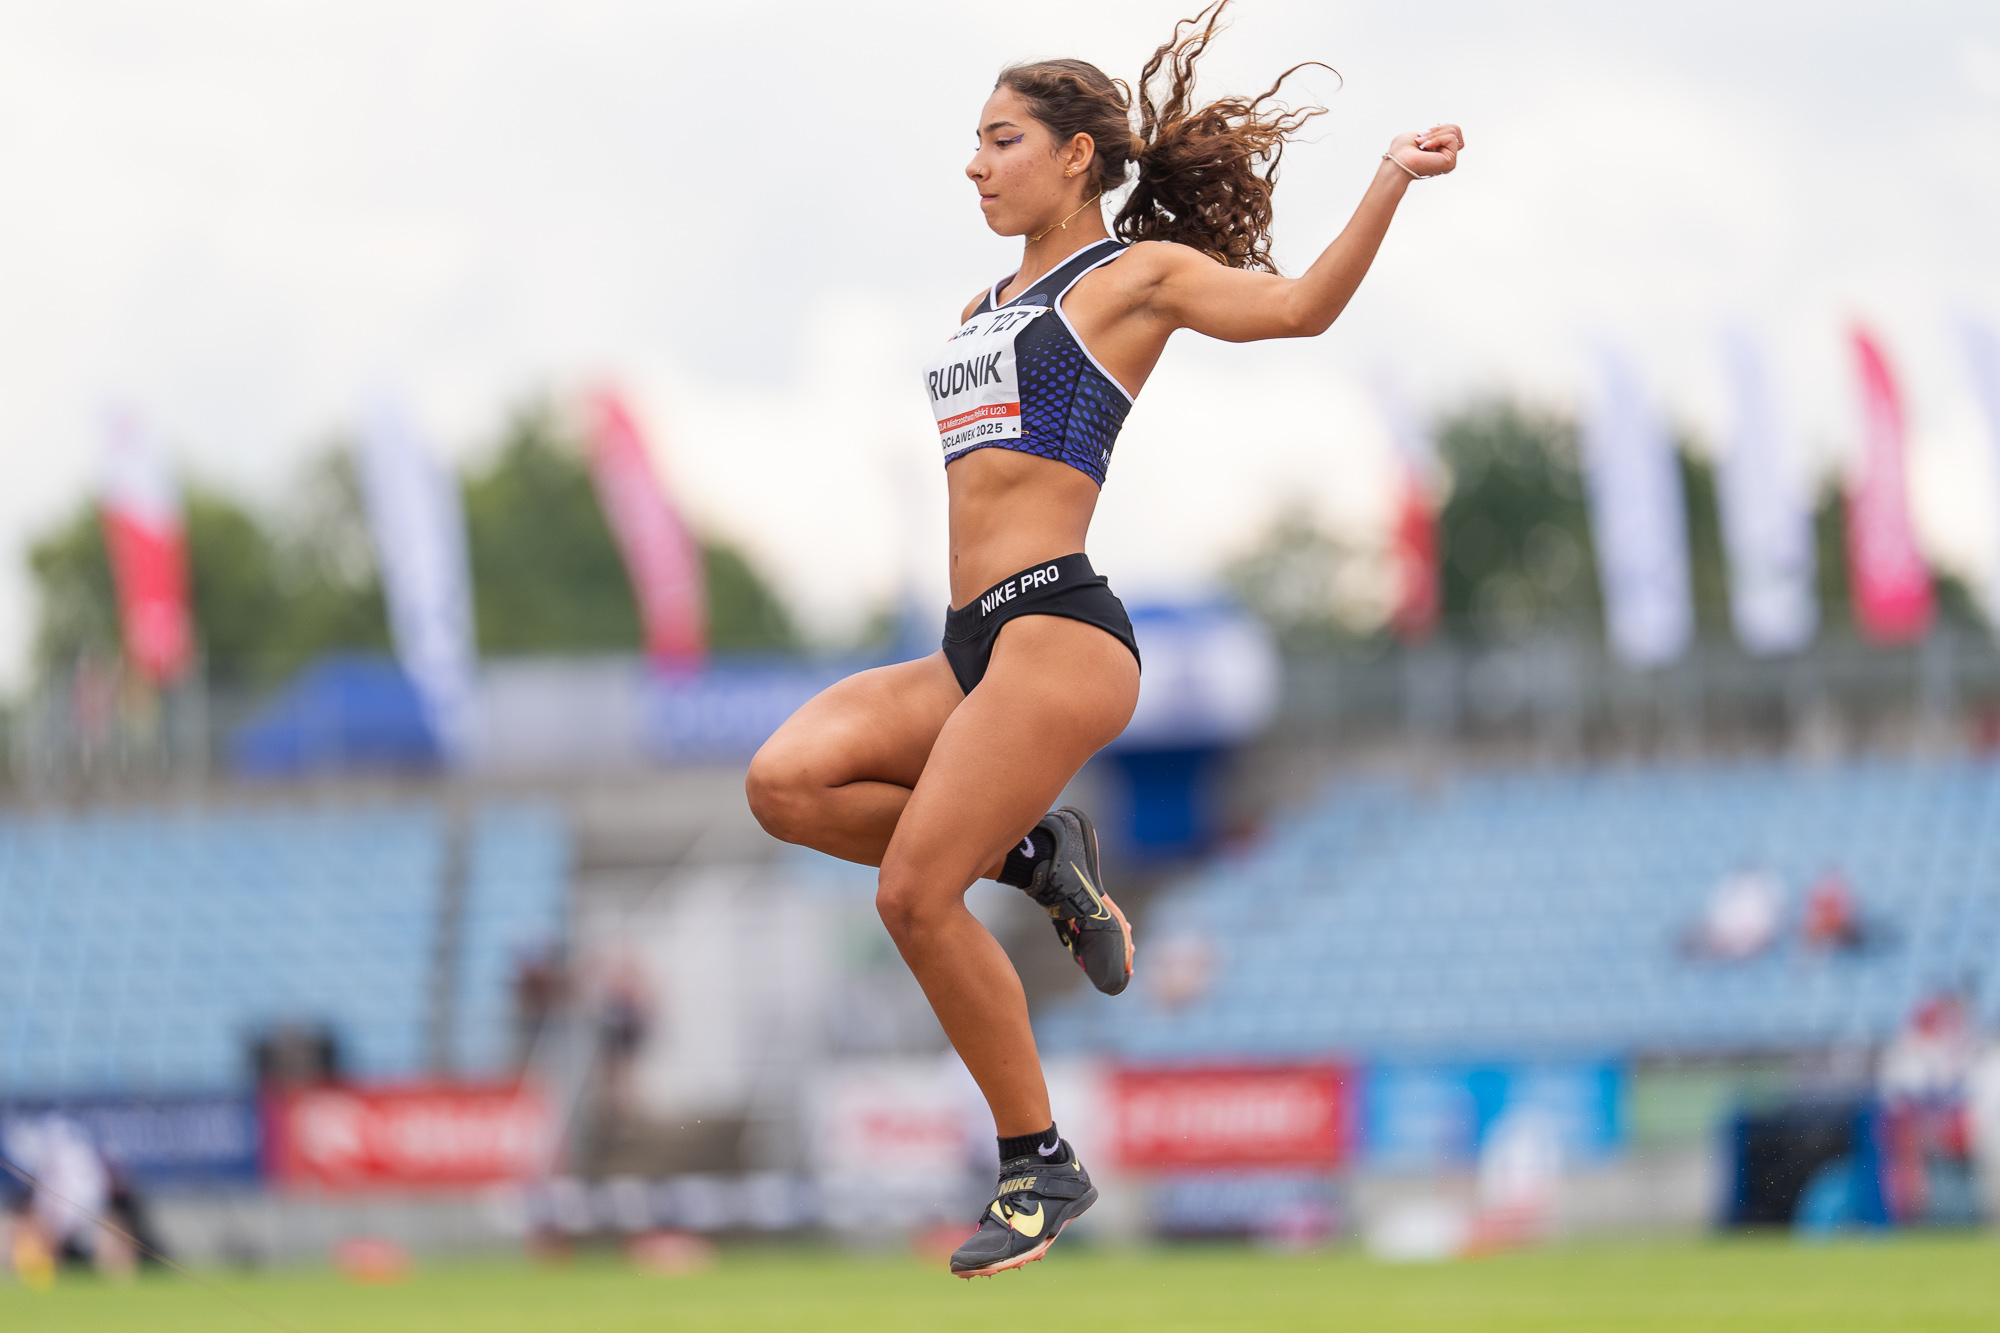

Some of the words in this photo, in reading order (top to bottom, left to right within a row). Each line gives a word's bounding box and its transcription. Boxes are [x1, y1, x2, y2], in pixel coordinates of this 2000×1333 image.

[983, 311, 1031, 336] 727
[928, 351, 1003, 402] RUDNIK
[990, 405, 1007, 415] U20
[976, 422, 1003, 437] 2025
[981, 580, 1017, 617] NIKE
[1020, 565, 1060, 594] PRO
[997, 1176, 1038, 1197] NIKE
